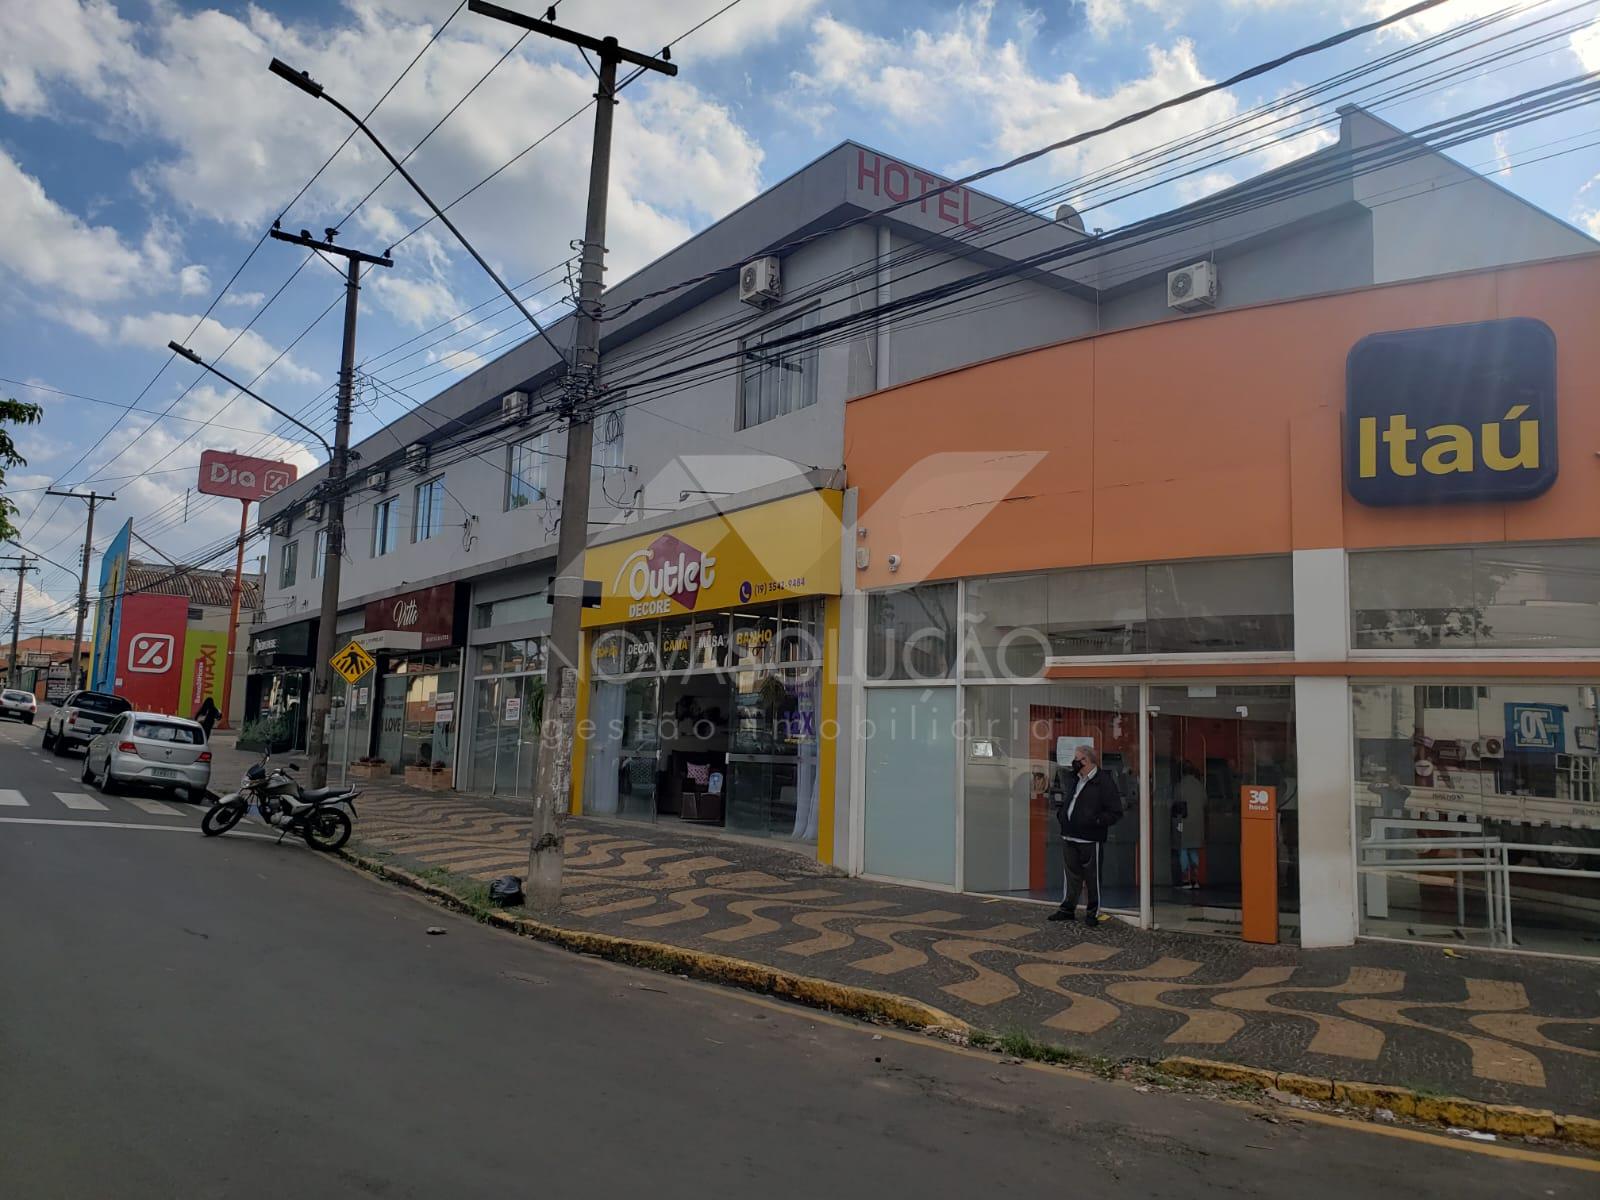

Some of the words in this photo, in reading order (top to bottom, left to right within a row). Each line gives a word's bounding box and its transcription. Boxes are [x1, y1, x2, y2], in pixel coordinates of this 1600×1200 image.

[858, 150, 982, 232] HOTEL
[1359, 405, 1539, 478] Itaú
[627, 550, 716, 601] Outlet
[754, 582, 767, 597] (19)
[393, 599, 418, 628] Vitto
[629, 599, 672, 618] DECORE
[628, 641, 655, 655] DECOR
[663, 639, 688, 652] CAMA
[736, 629, 773, 645] BANHO
[1248, 790, 1269, 804] 30
[1248, 804, 1269, 812] horas
